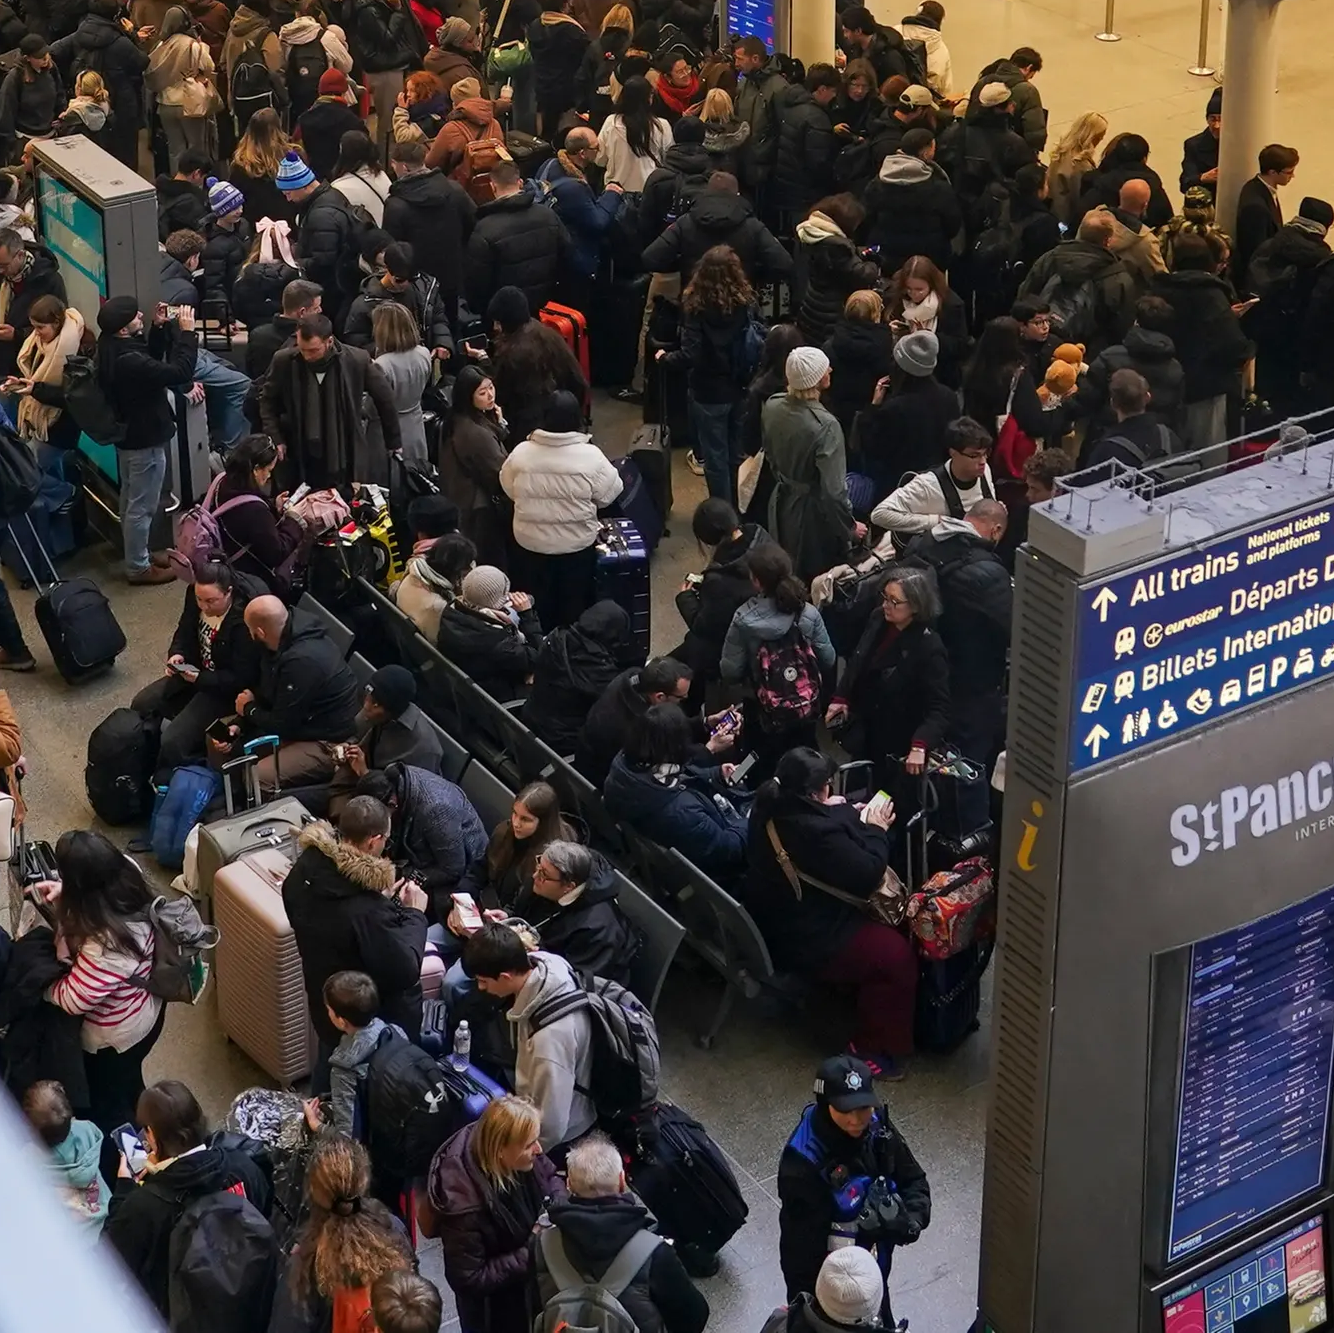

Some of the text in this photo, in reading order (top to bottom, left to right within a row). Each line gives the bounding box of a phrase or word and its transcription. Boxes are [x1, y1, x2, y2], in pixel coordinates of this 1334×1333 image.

[1247, 530, 1321, 565] and platforms
[1248, 511, 1330, 549] National tickets
[1130, 552, 1240, 607] All trains
[1164, 605, 1224, 637] eurostar
[1230, 568, 1319, 616] Départs
[1142, 645, 1217, 692] Billets
